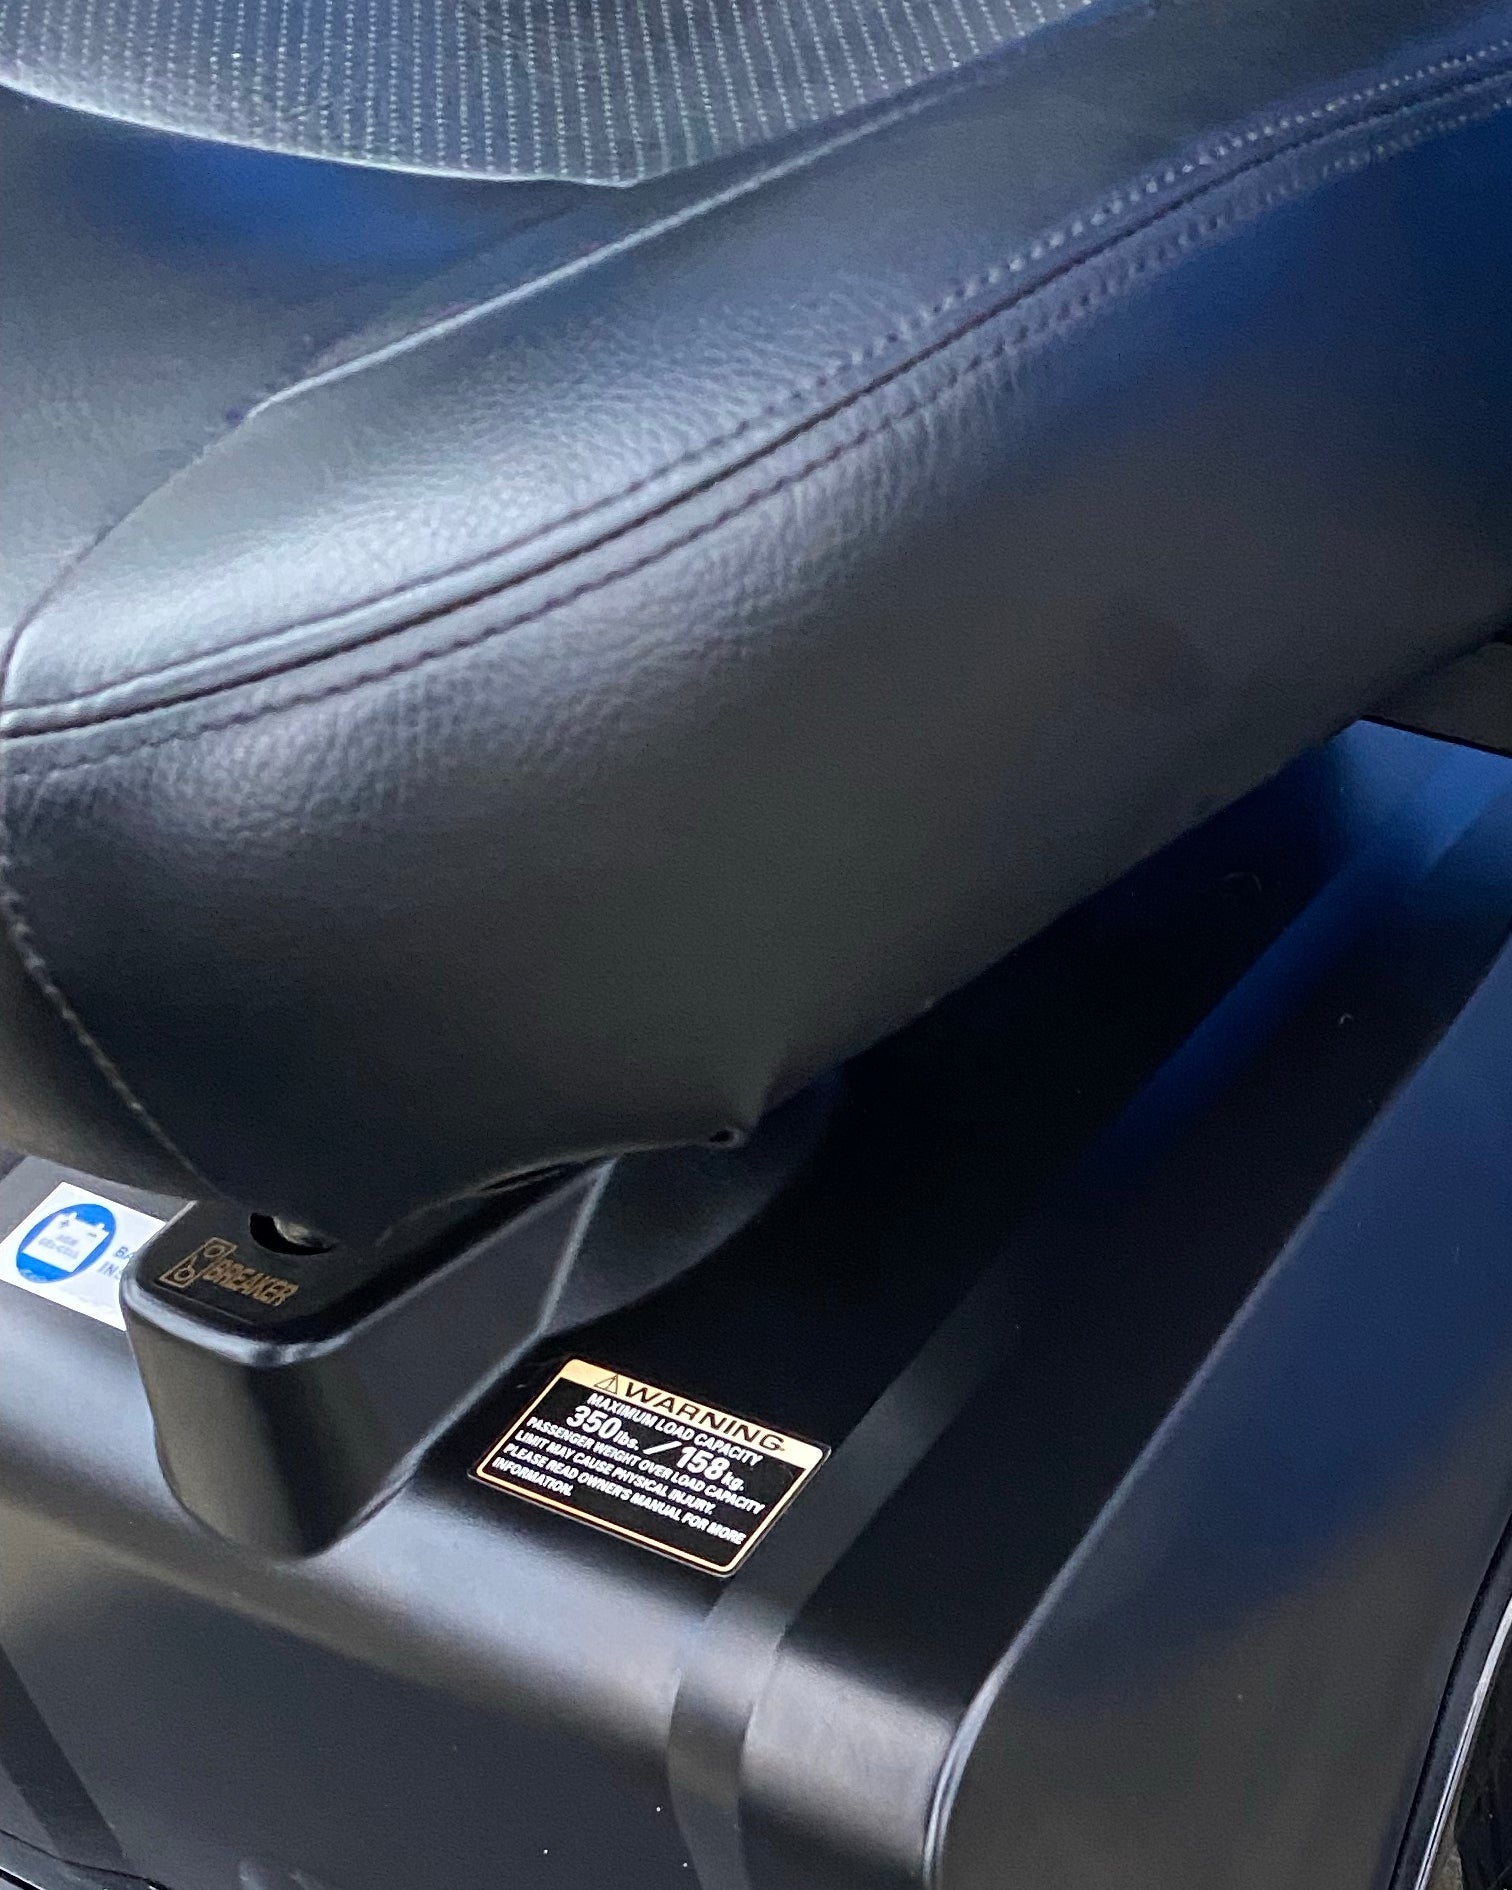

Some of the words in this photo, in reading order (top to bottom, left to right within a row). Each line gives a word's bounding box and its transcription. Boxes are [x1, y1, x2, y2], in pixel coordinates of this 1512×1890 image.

[202, 1259, 299, 1306] BREAKER
[587, 1393, 658, 1427] MAXIMUM
[655, 1418, 695, 1440] LOAD
[694, 1433, 763, 1466] CAPACITY
[625, 1382, 784, 1451] WARNING
[503, 1443, 549, 1467] PLEASE
[545, 1460, 579, 1479] READ
[629, 1492, 682, 1521] MANUAL
[678, 1512, 709, 1531] FOR
[706, 1522, 746, 1544] MORE
[515, 1430, 550, 1449] LIMIT
[546, 1442, 575, 1459] MAY
[572, 1452, 615, 1475] CAUSE
[611, 1467, 668, 1497] PHYSICAL
[526, 1416, 595, 1449] PASSENGER
[593, 1441, 641, 1466] WEIGHT
[638, 1459, 673, 1480] OVER
[670, 1471, 706, 1492] LOAD
[704, 1485, 765, 1514] CAPACITY
